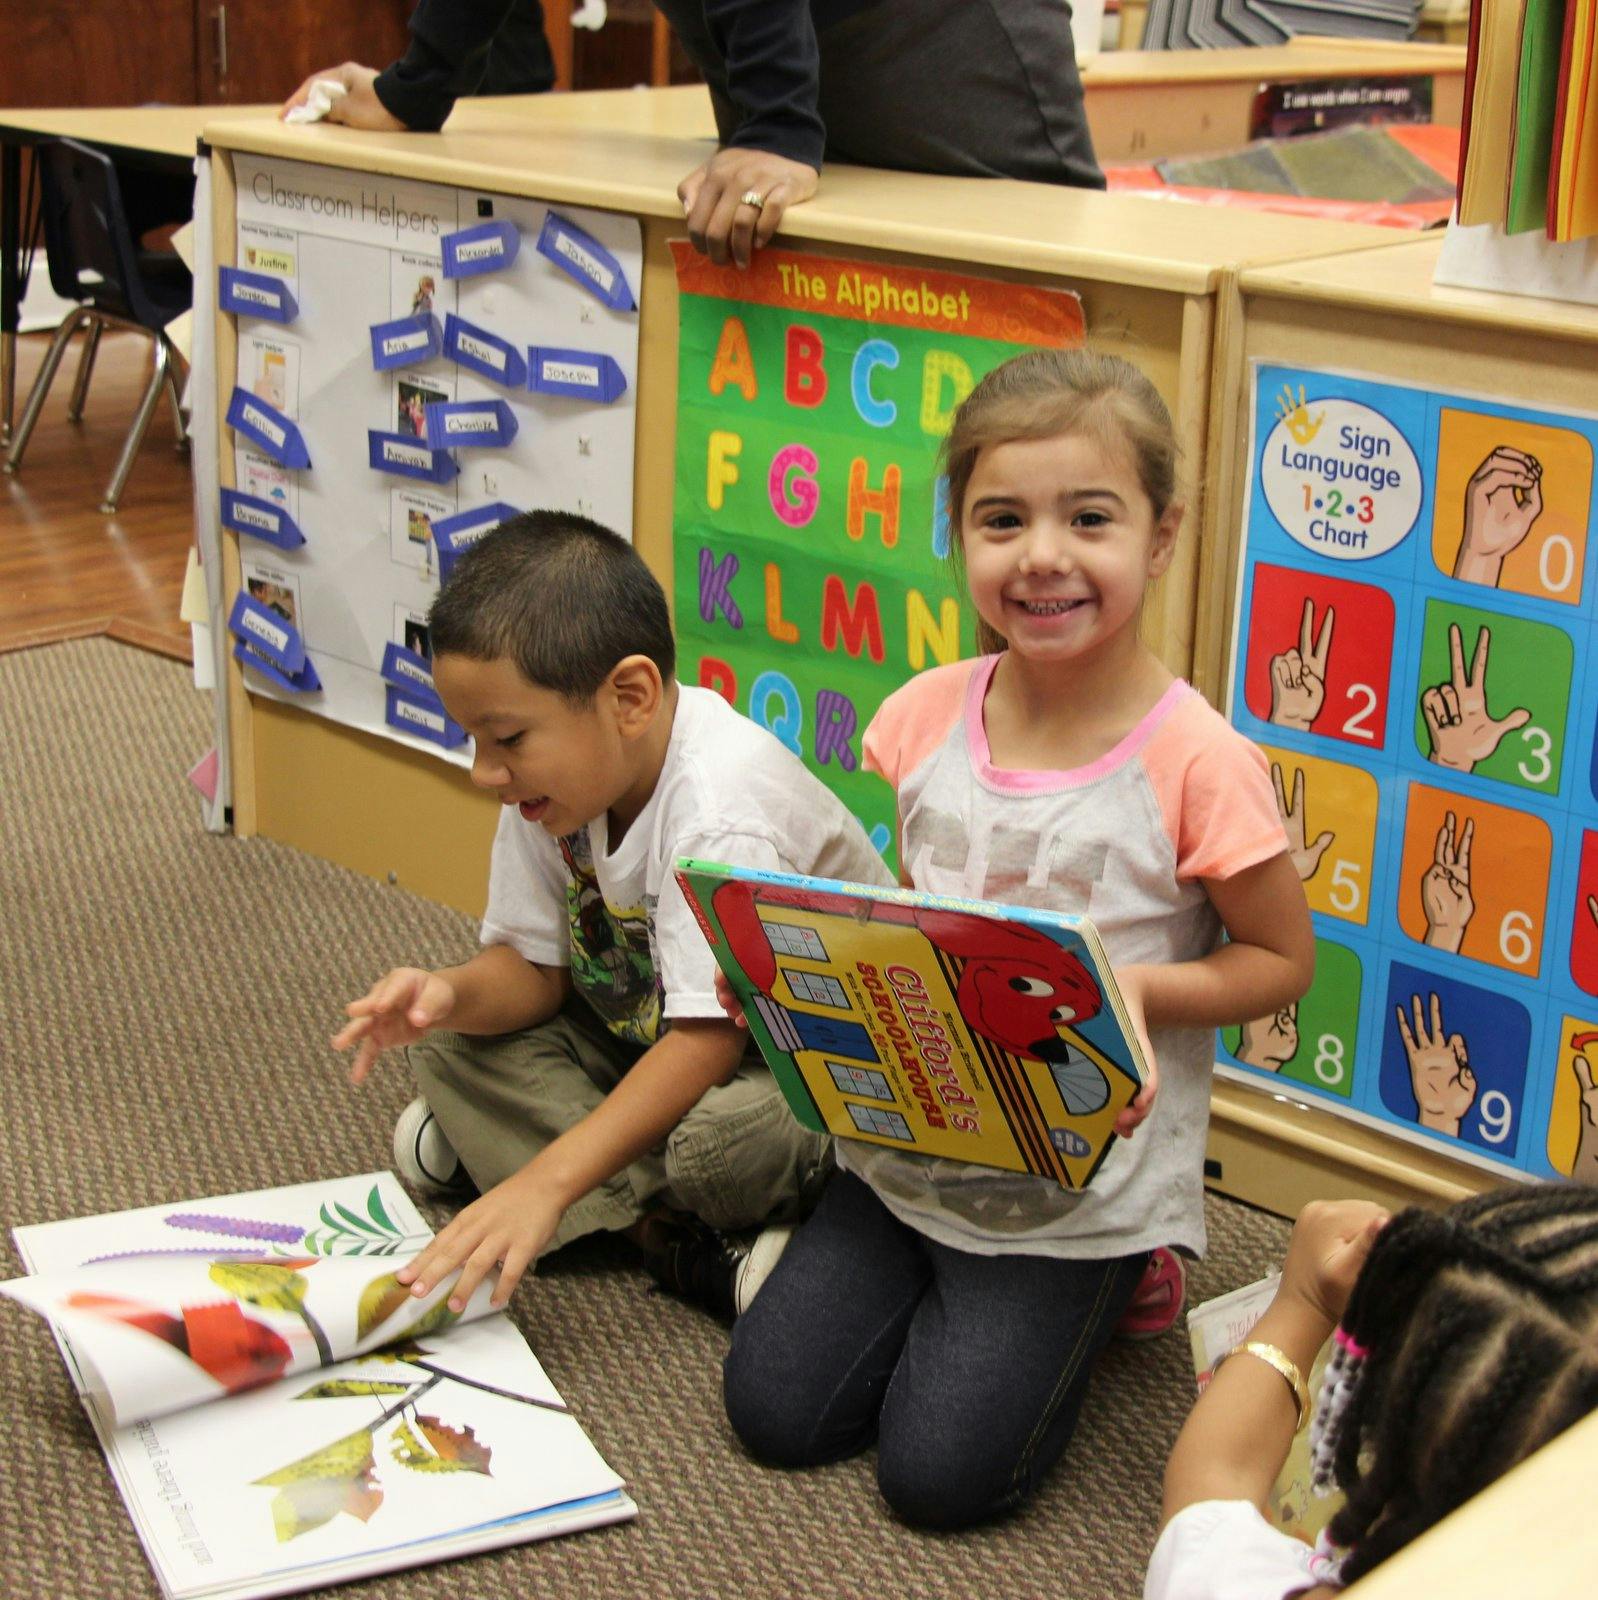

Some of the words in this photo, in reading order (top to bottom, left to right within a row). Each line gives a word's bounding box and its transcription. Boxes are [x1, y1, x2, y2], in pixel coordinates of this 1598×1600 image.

[253, 172, 353, 219] Classroom
[361, 190, 440, 241] Helpers
[564, 242, 602, 283] Jason
[777, 264, 827, 300] The
[836, 272, 971, 321] Alphabet
[708, 316, 758, 401] A
[784, 324, 828, 409] B
[851, 339, 900, 428] C
[920, 349, 975, 436] D
[1281, 444, 1401, 490] Language
[1340, 426, 1391, 459] Sign
[706, 430, 743, 511] F
[768, 443, 820, 528] G
[846, 456, 901, 549] H
[1309, 519, 1368, 550] Chart
[1539, 534, 1575, 593] 0
[698, 547, 744, 630] K
[764, 563, 799, 644] L
[820, 574, 886, 664] M
[906, 588, 959, 670] N
[749, 671, 802, 758] Q
[815, 689, 857, 772] R
[1342, 682, 1377, 739] 2
[1517, 726, 1552, 783] 3
[1328, 860, 1361, 913] 5
[1499, 910, 1533, 965] 6
[856, 960, 947, 1131] SCHOOLHOUSE
[885, 964, 981, 1136] Clifford's
[1314, 1033, 1345, 1086] 8
[1479, 1090, 1512, 1144] 9
